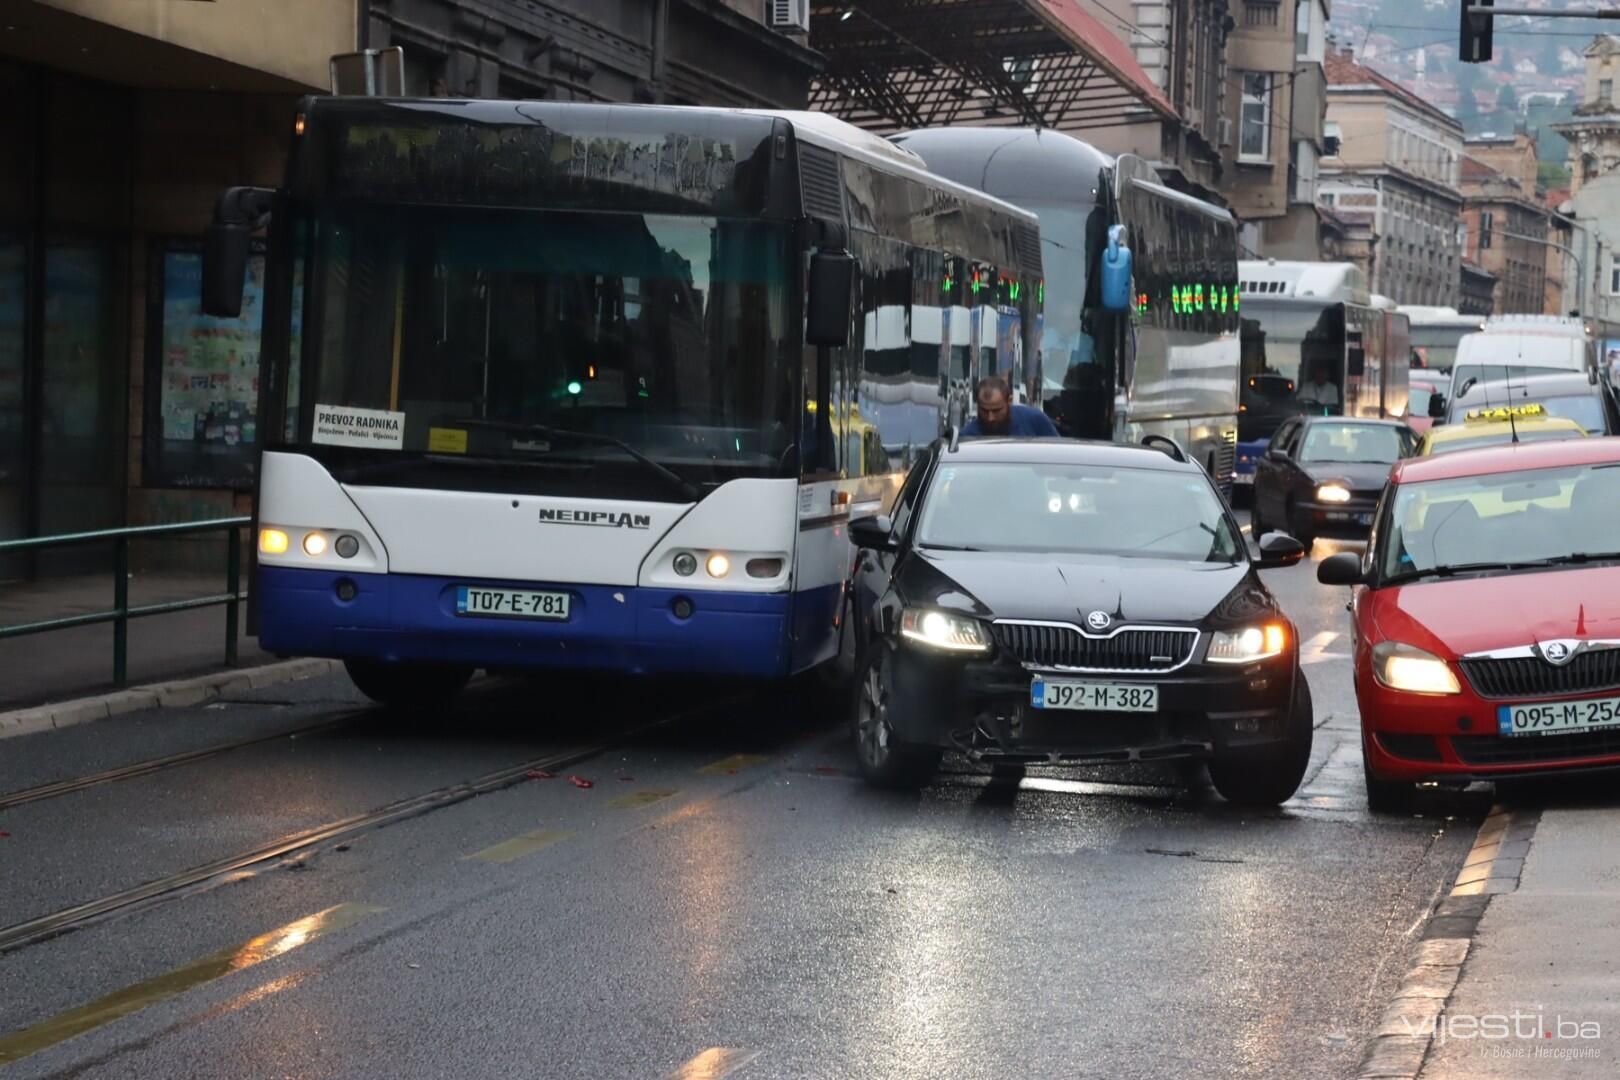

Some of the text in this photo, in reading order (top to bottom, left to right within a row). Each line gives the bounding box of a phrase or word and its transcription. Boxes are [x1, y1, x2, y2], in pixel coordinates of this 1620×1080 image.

[318, 412, 399, 430] PREVOZ RADNIKA
[539, 509, 650, 528] NEOPLAN
[470, 591, 565, 614] T07-E-781
[1048, 685, 1154, 708] J92-M-382
